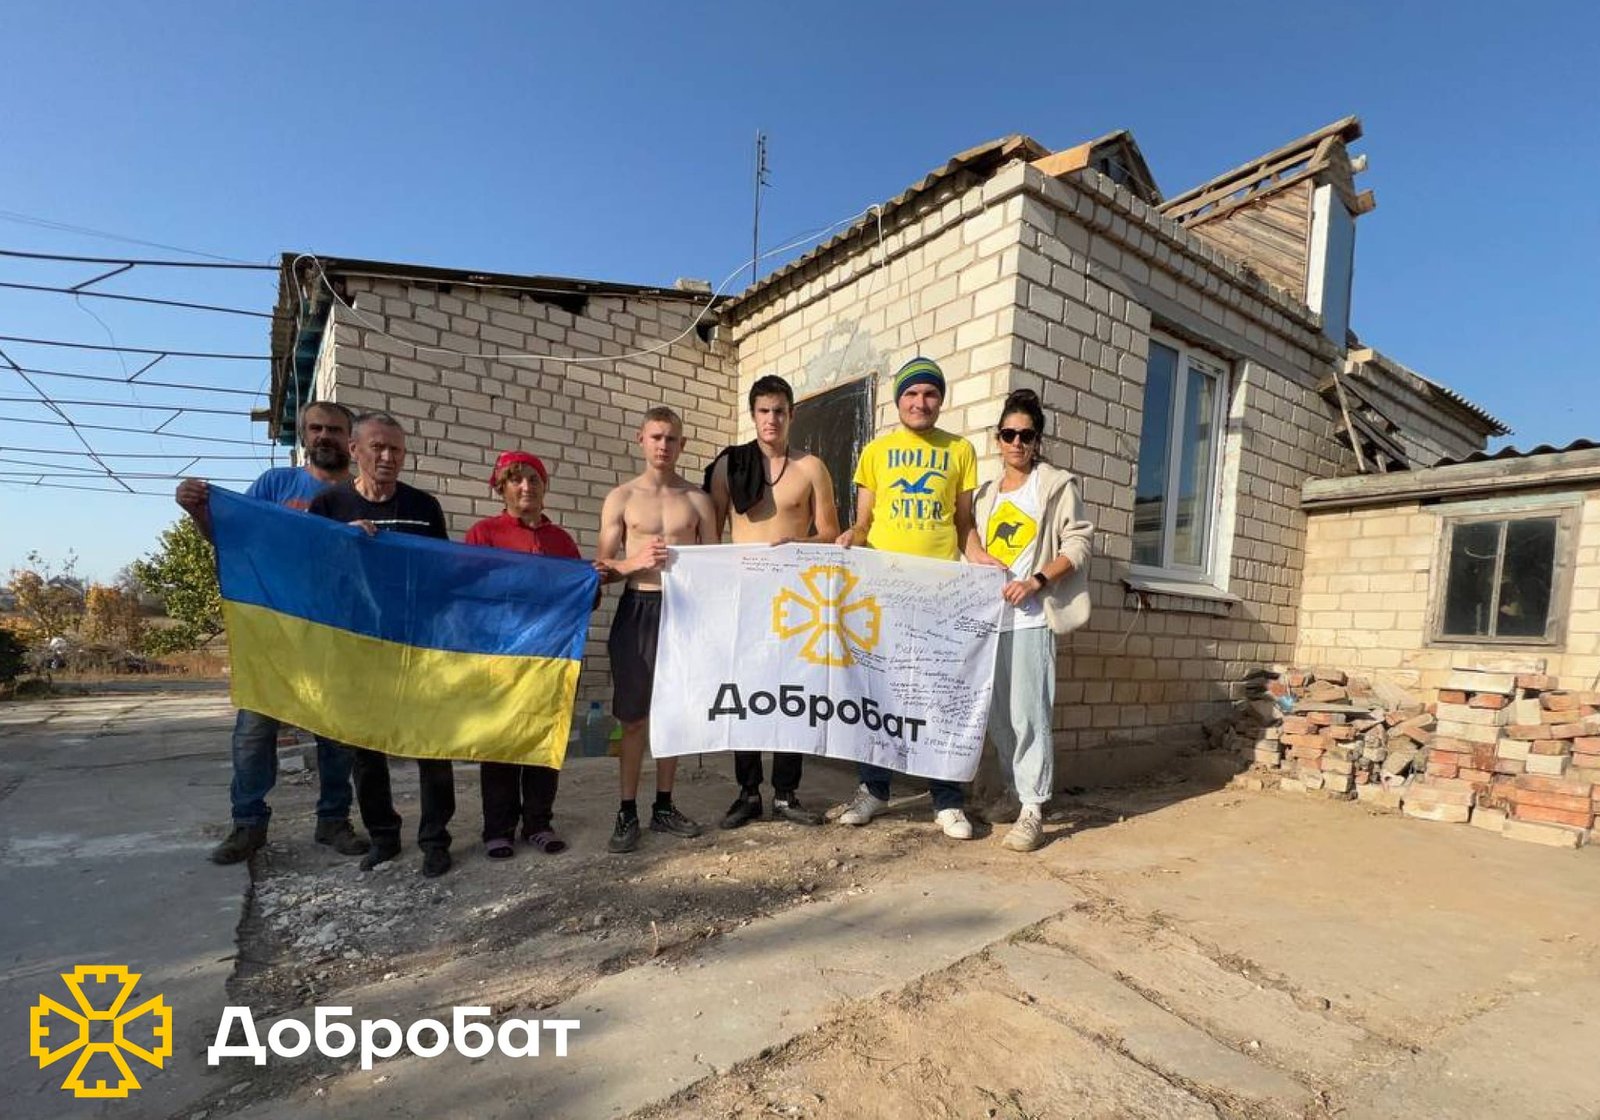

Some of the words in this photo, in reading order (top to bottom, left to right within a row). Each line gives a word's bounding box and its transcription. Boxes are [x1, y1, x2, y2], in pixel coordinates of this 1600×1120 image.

[888, 449, 949, 471] HOLLI
[891, 498, 943, 521] STER
[708, 683, 927, 742] Добробат
